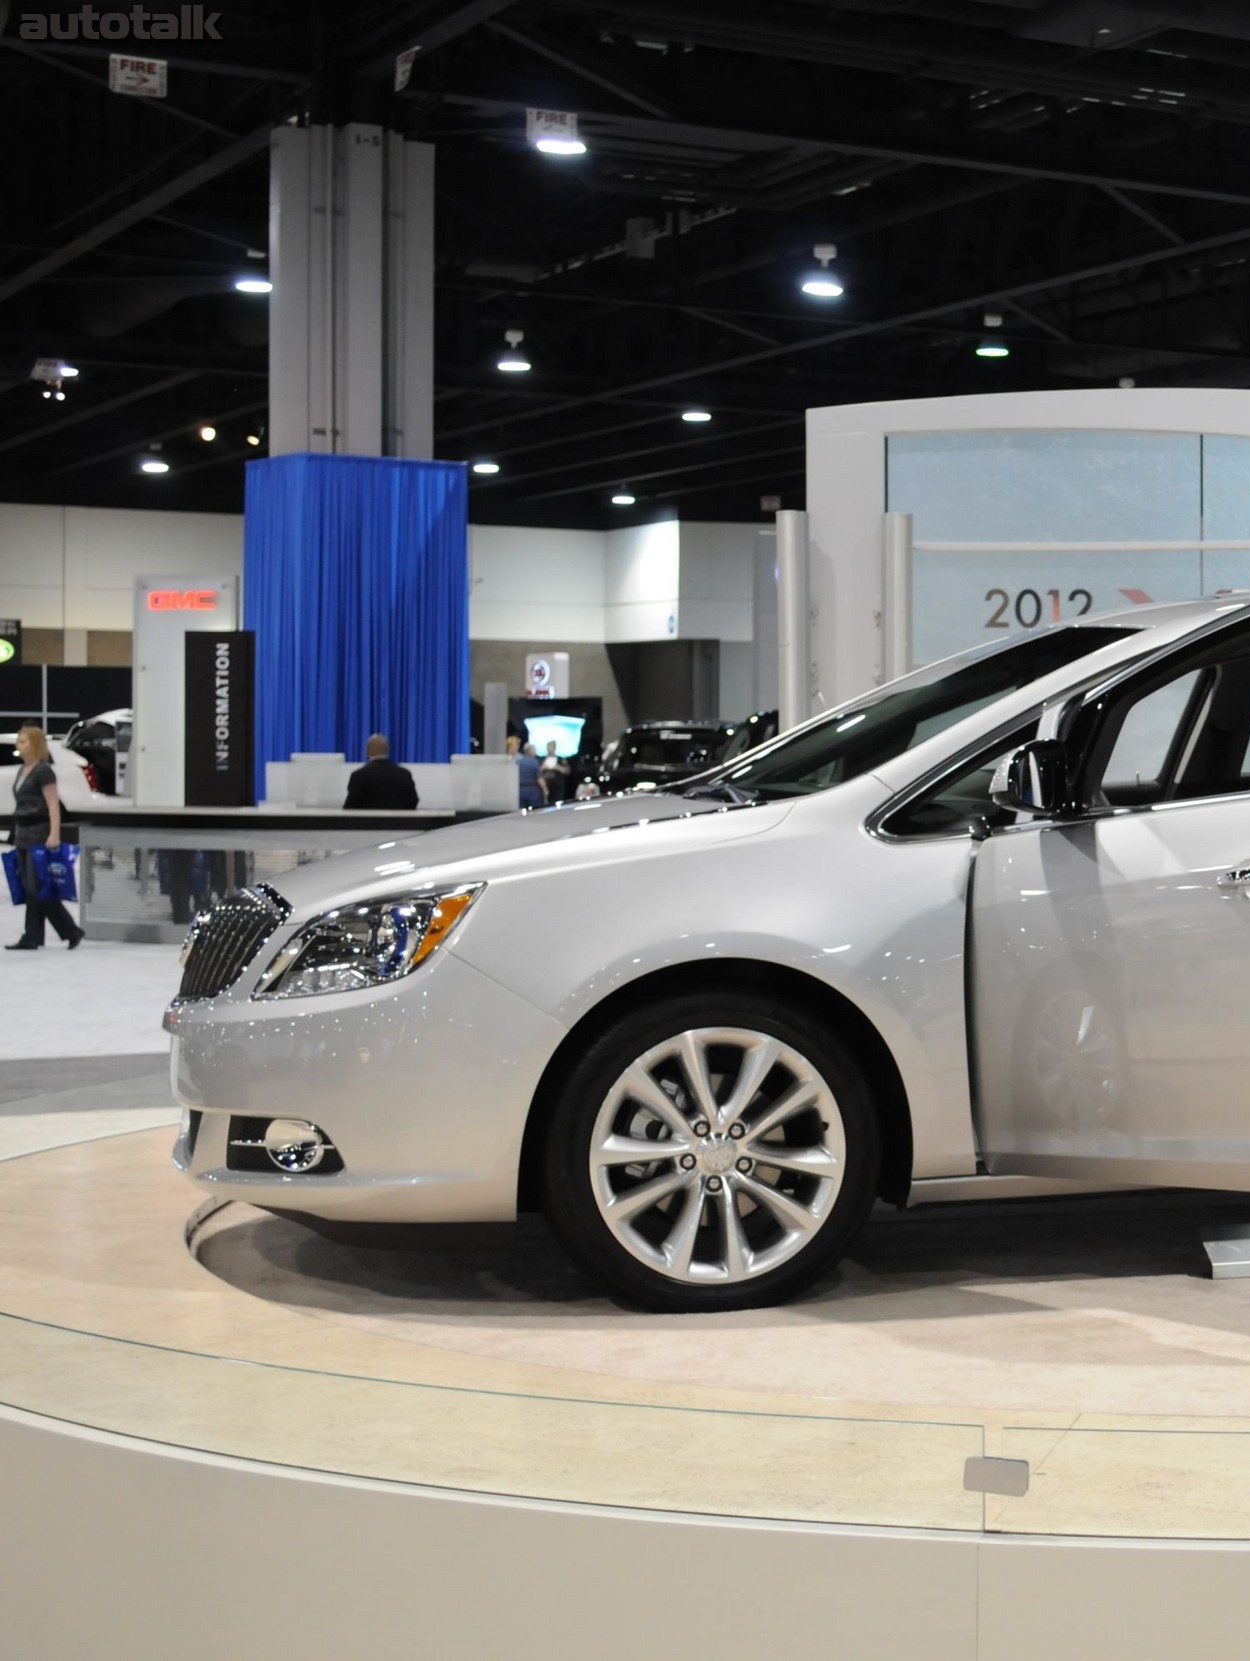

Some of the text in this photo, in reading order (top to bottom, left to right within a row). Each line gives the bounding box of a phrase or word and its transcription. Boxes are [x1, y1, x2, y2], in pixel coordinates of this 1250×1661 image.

[120, 58, 157, 75] FIRE
[536, 110, 568, 126] FIRE
[147, 589, 217, 611] GMC
[984, 588, 1093, 628] 2012
[215, 642, 230, 771] INFORMATION
